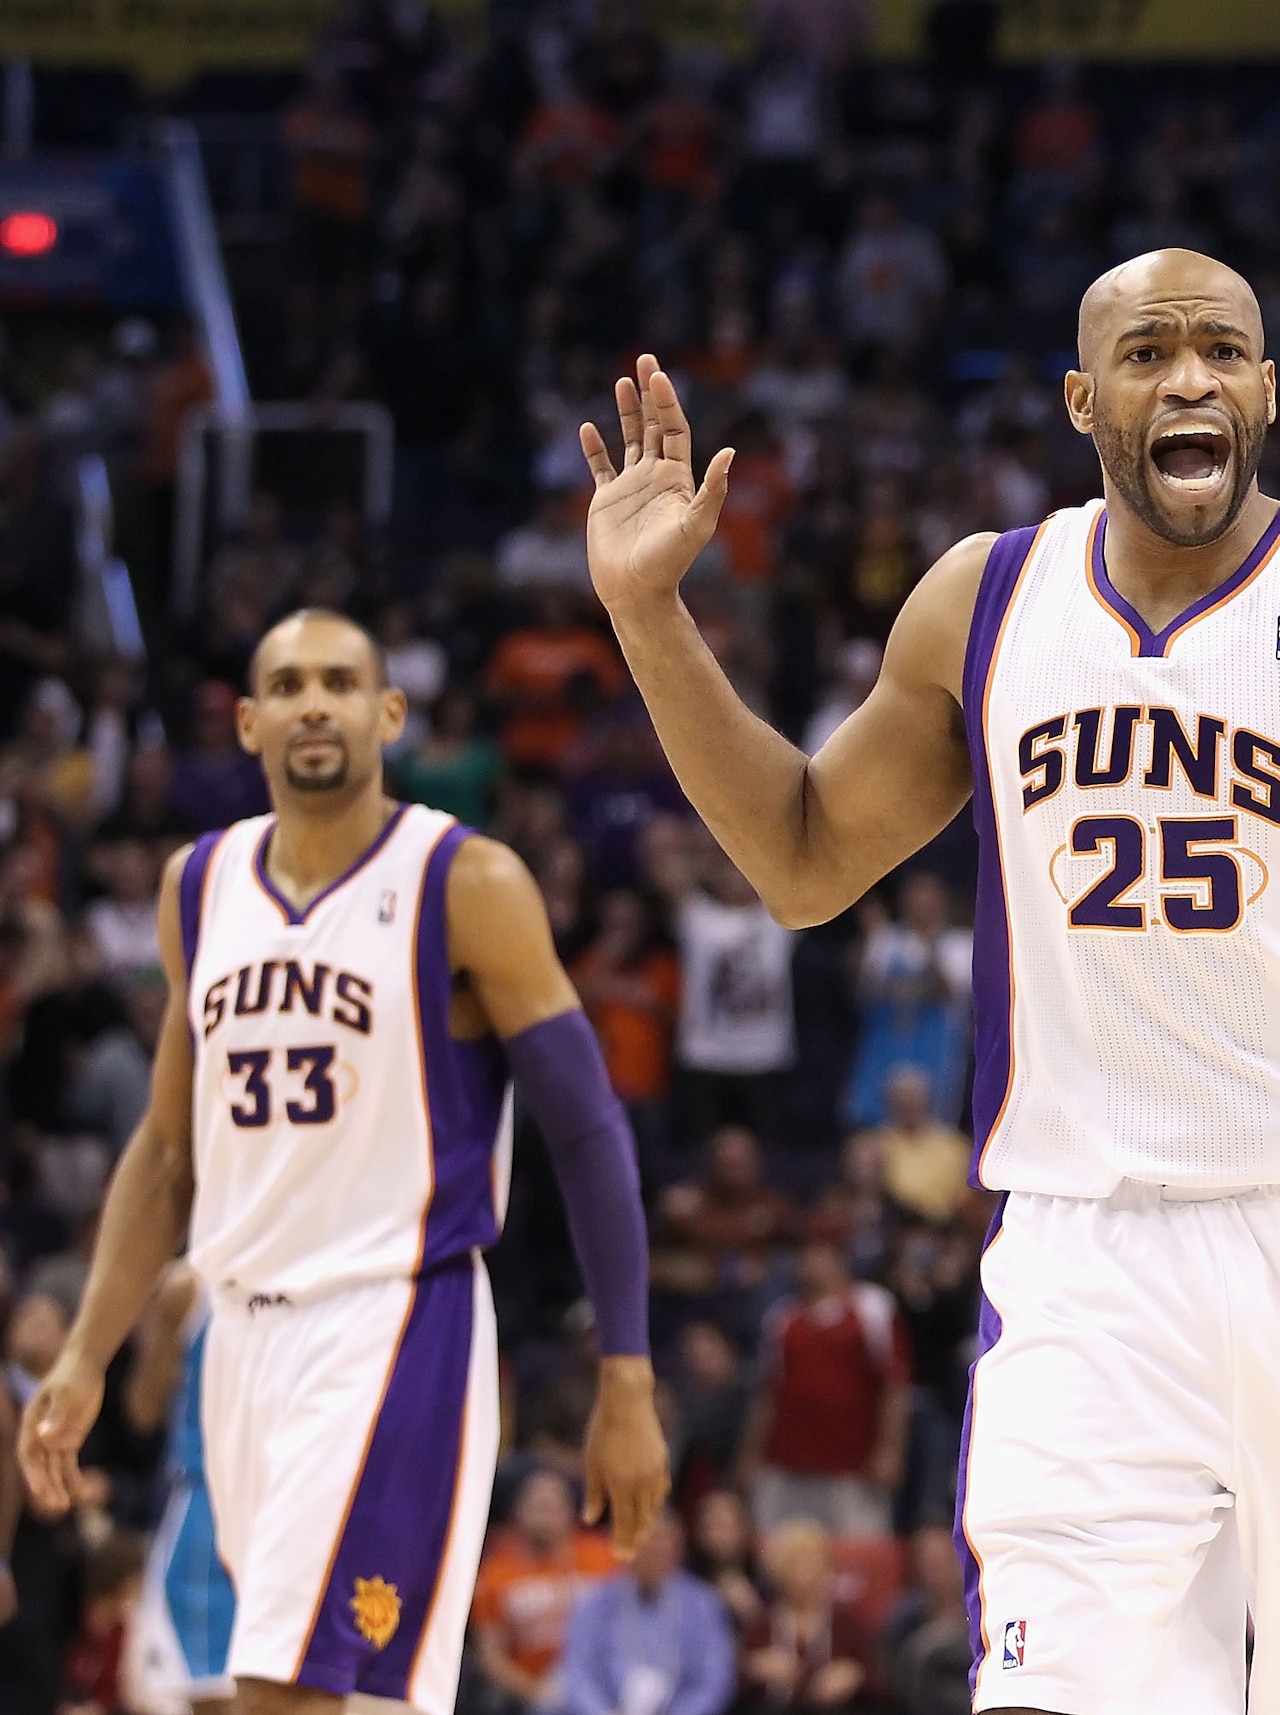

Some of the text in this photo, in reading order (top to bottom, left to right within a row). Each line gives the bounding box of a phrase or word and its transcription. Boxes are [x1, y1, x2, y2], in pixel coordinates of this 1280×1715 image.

[1068, 813, 1244, 935] 25
[204, 959, 373, 1040] SUNS
[226, 1045, 337, 1128] 33
